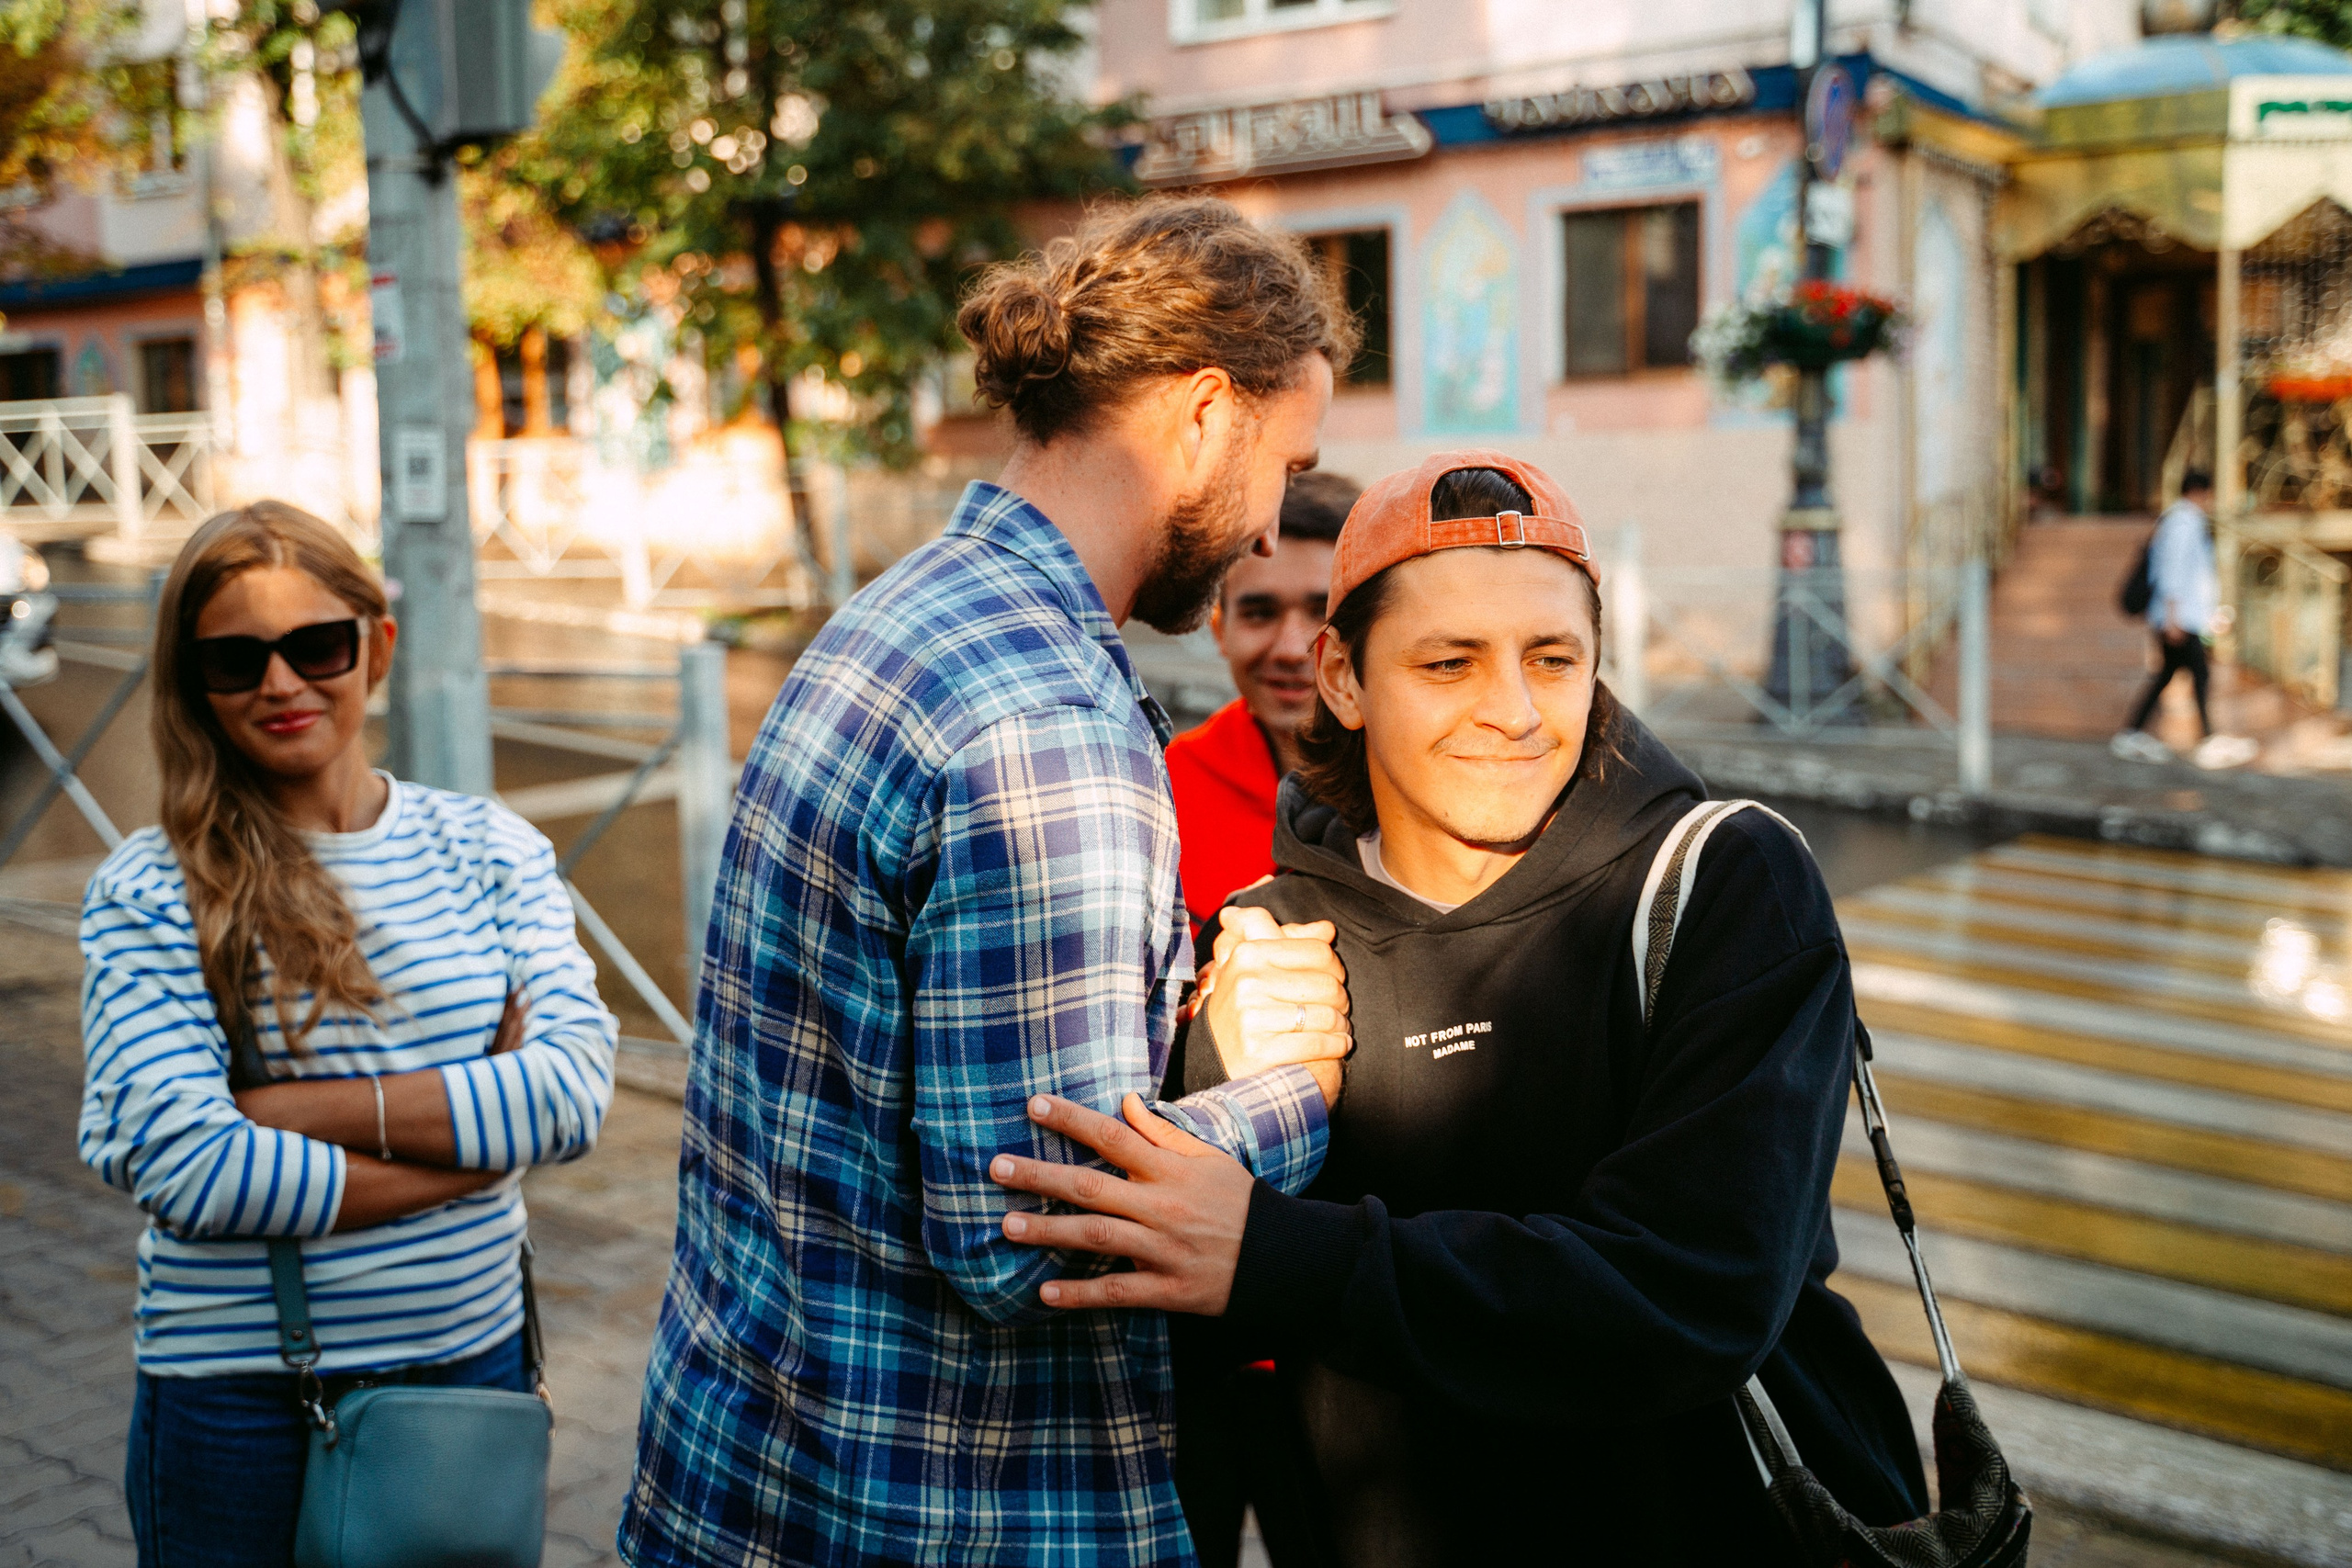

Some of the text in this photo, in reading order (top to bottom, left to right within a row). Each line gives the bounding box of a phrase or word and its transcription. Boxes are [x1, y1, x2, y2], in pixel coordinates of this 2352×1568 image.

[1405, 1034, 1427, 1047] NOT
[1430, 1025, 1463, 1043] FROM
[1433, 1040, 1476, 1059] MADAME
